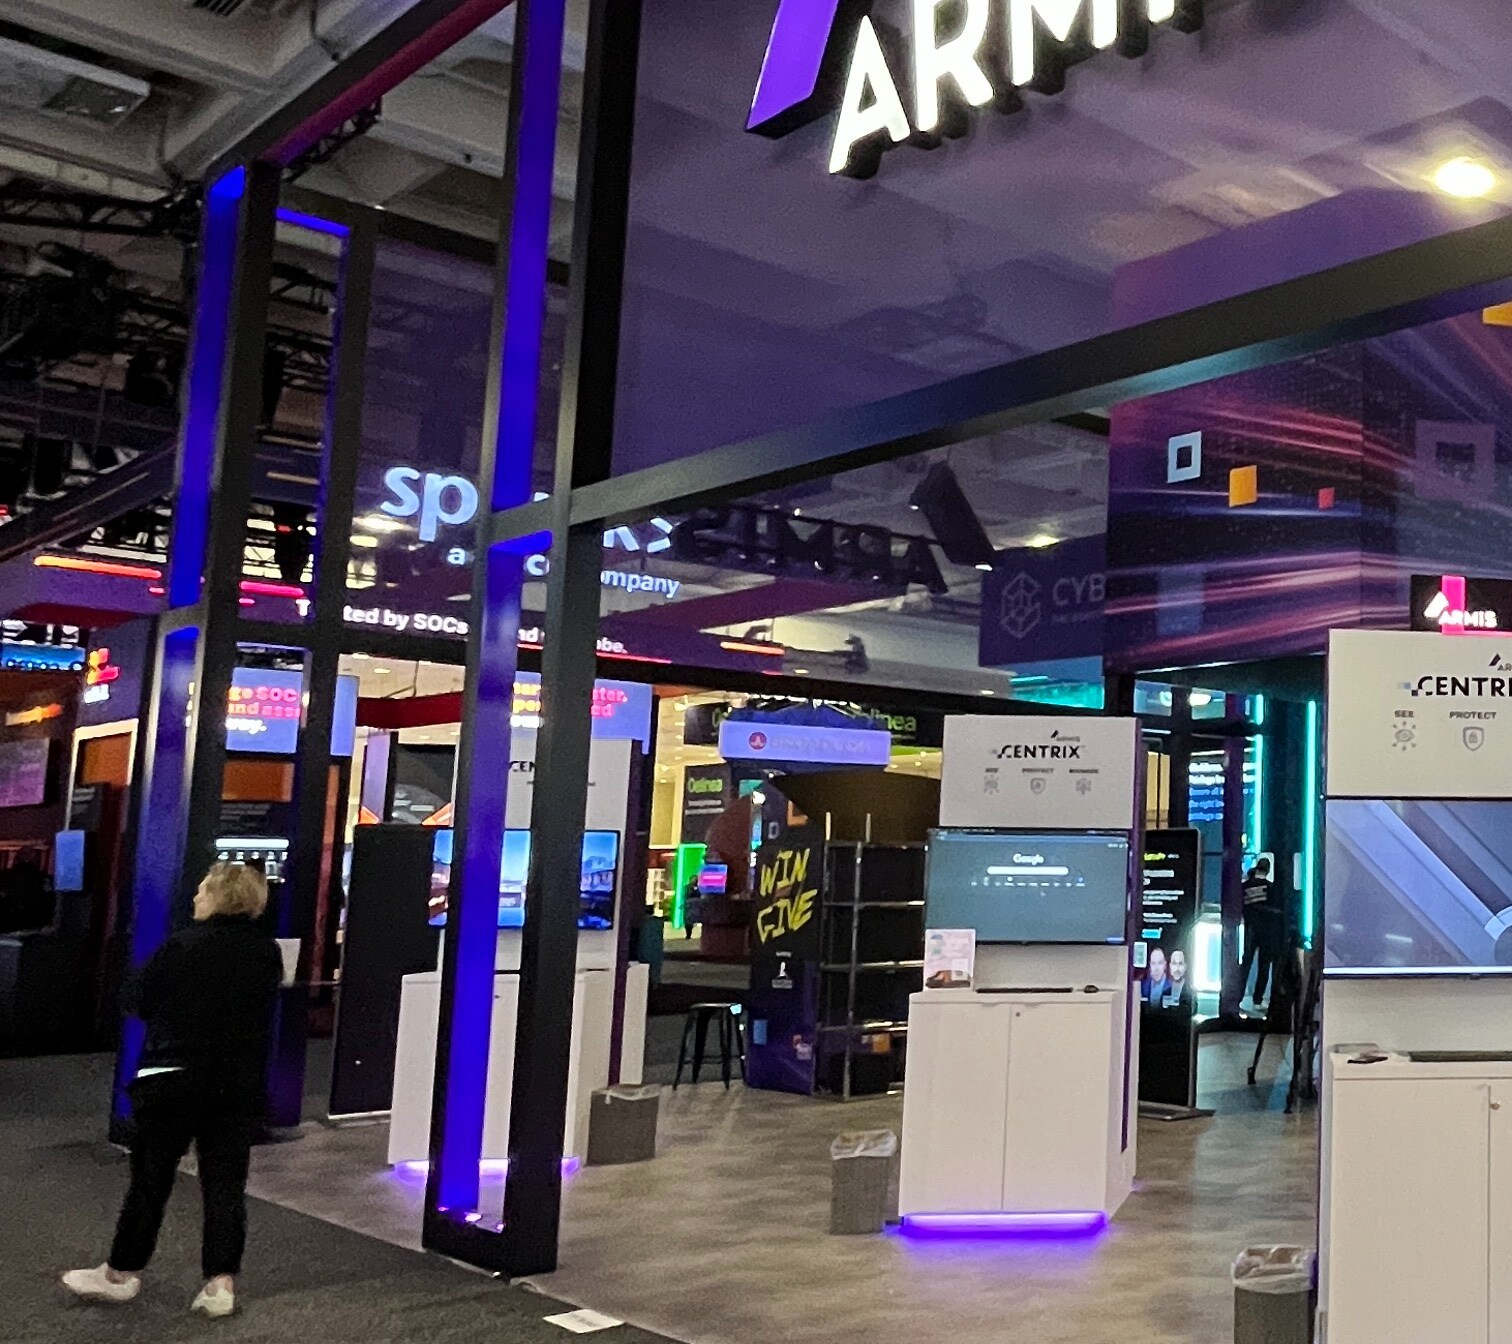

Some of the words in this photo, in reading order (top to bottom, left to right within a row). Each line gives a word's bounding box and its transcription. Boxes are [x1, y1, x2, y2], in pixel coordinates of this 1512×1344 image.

[382, 609, 409, 631] by
[413, 612, 469, 635] SOCs
[1438, 610, 1499, 628] ARMIS
[1448, 710, 1498, 721] PROTECT
[999, 744, 1081, 760] CENTRIX
[759, 847, 812, 898] WIN
[756, 888, 819, 944] GIVE
